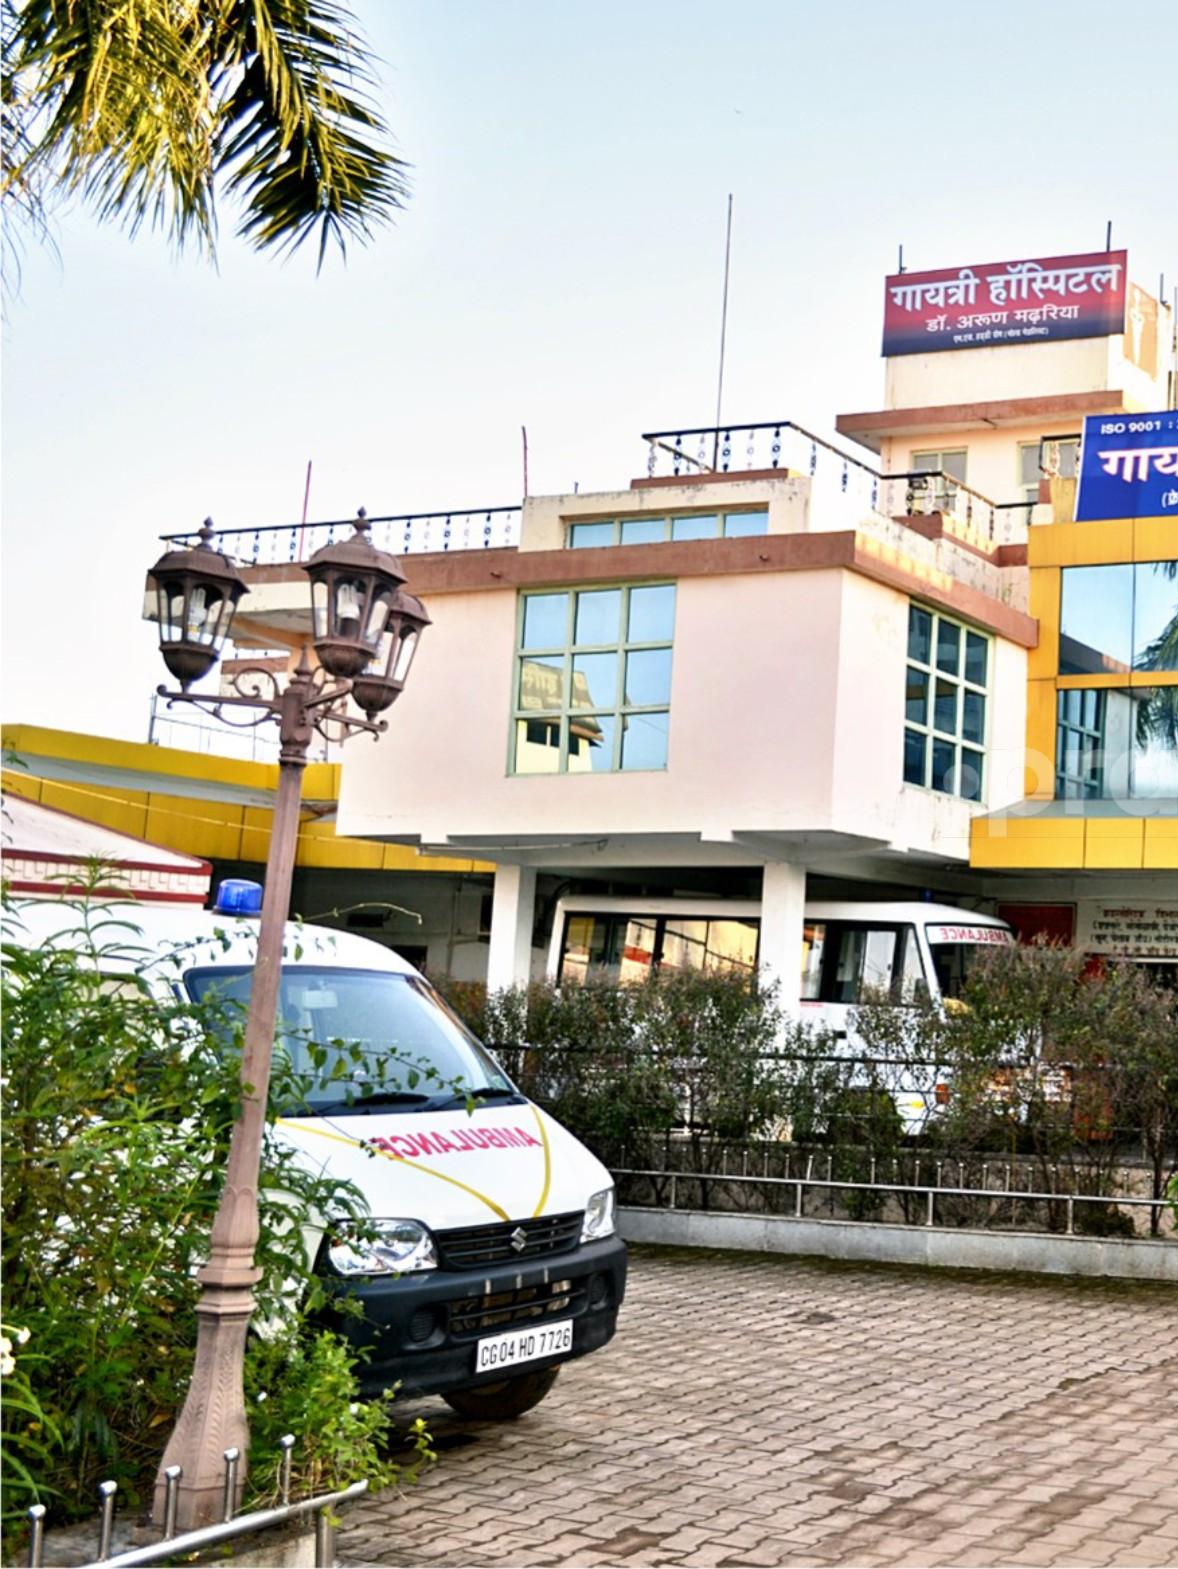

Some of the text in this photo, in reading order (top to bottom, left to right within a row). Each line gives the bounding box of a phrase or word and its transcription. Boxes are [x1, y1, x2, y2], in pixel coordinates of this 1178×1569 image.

[890, 262, 1122, 312] गायत्री हॉस्पिटल
[926, 303, 1080, 332] डॉ. अरूण मढ़रिया
[1101, 424, 1125, 435] ISO
[1129, 420, 1162, 432] 9001
[539, 1328, 571, 1353] 7726
